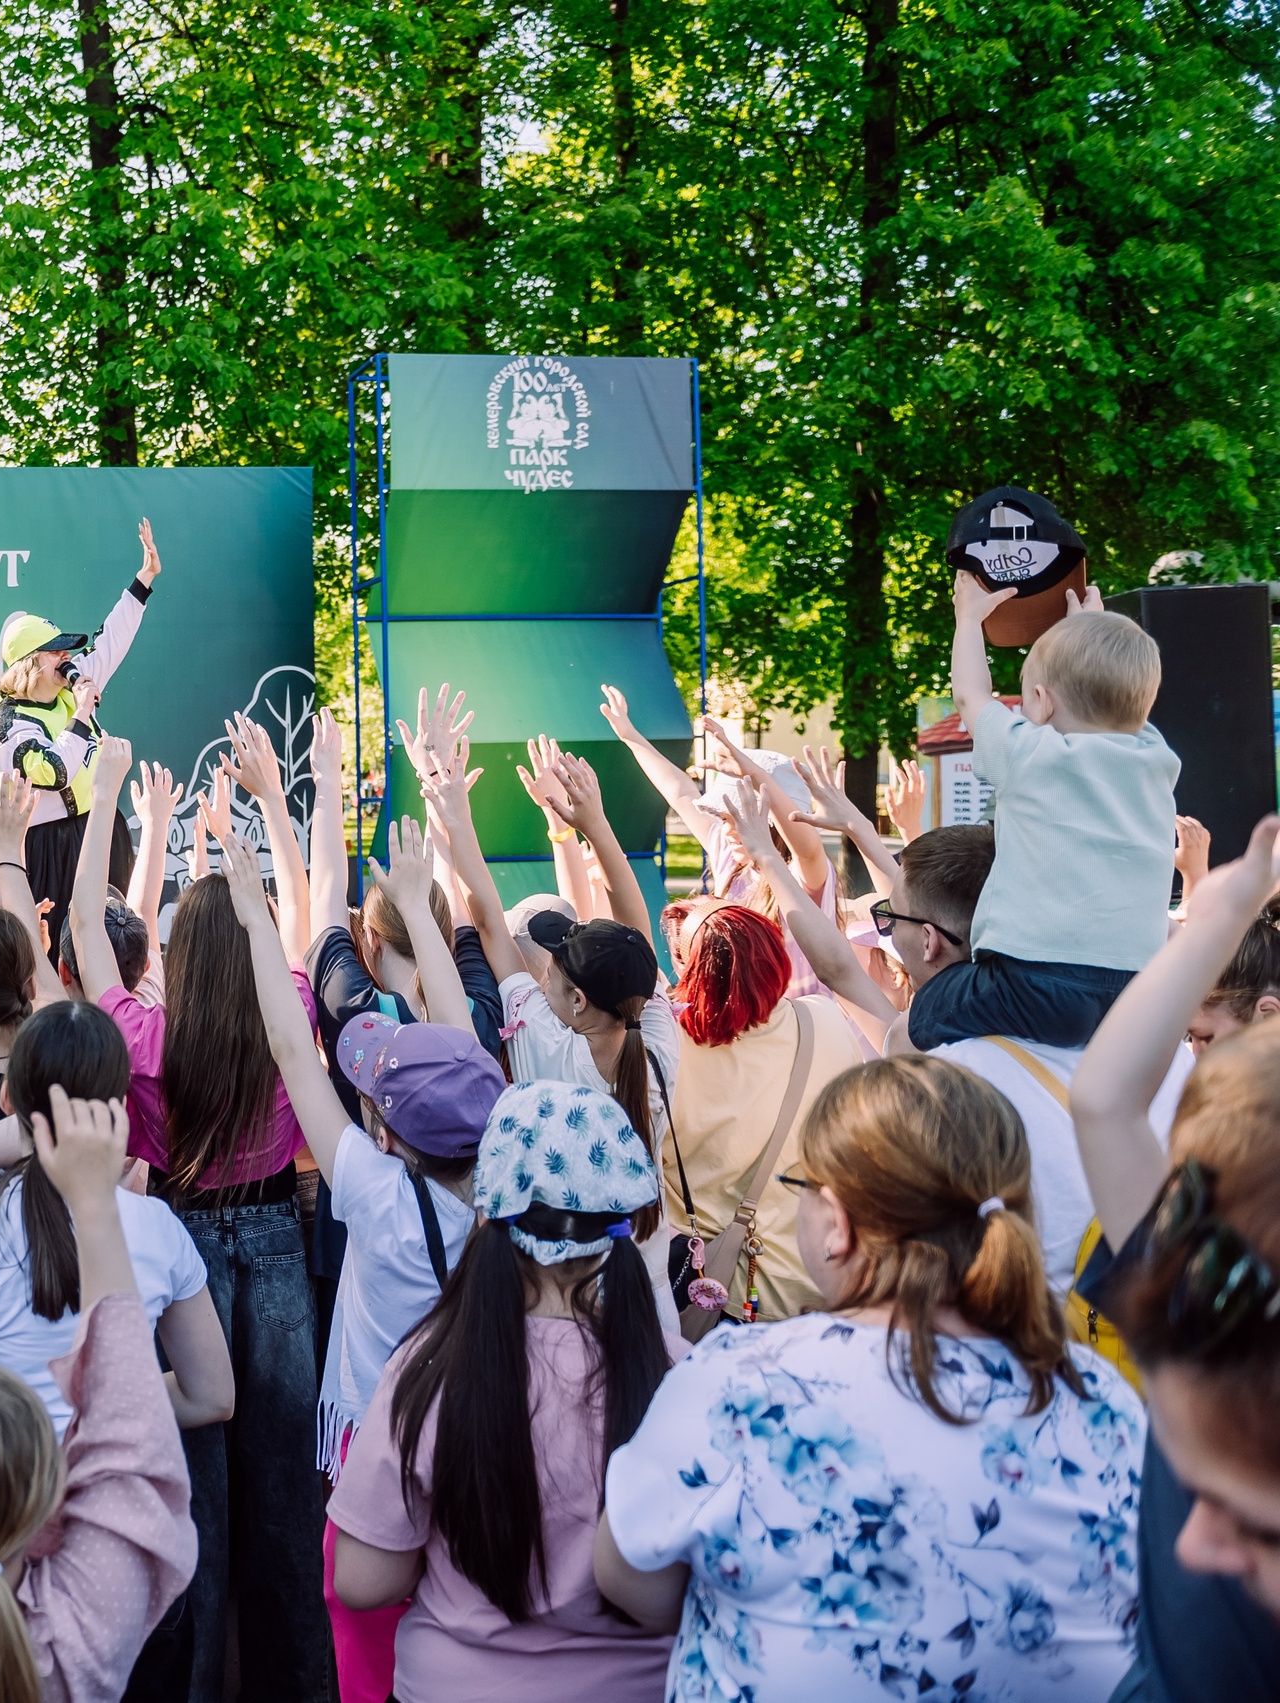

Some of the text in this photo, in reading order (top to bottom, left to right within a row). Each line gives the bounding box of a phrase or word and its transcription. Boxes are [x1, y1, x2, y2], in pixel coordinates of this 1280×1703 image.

[512, 371, 548, 393] 100
[485, 355, 592, 450] КЕМЕРОВСКИЙ ГОРОДСКОЙ САД
[509, 448, 568, 473] ПАРК
[504, 470, 574, 495] ЧУДЕС
